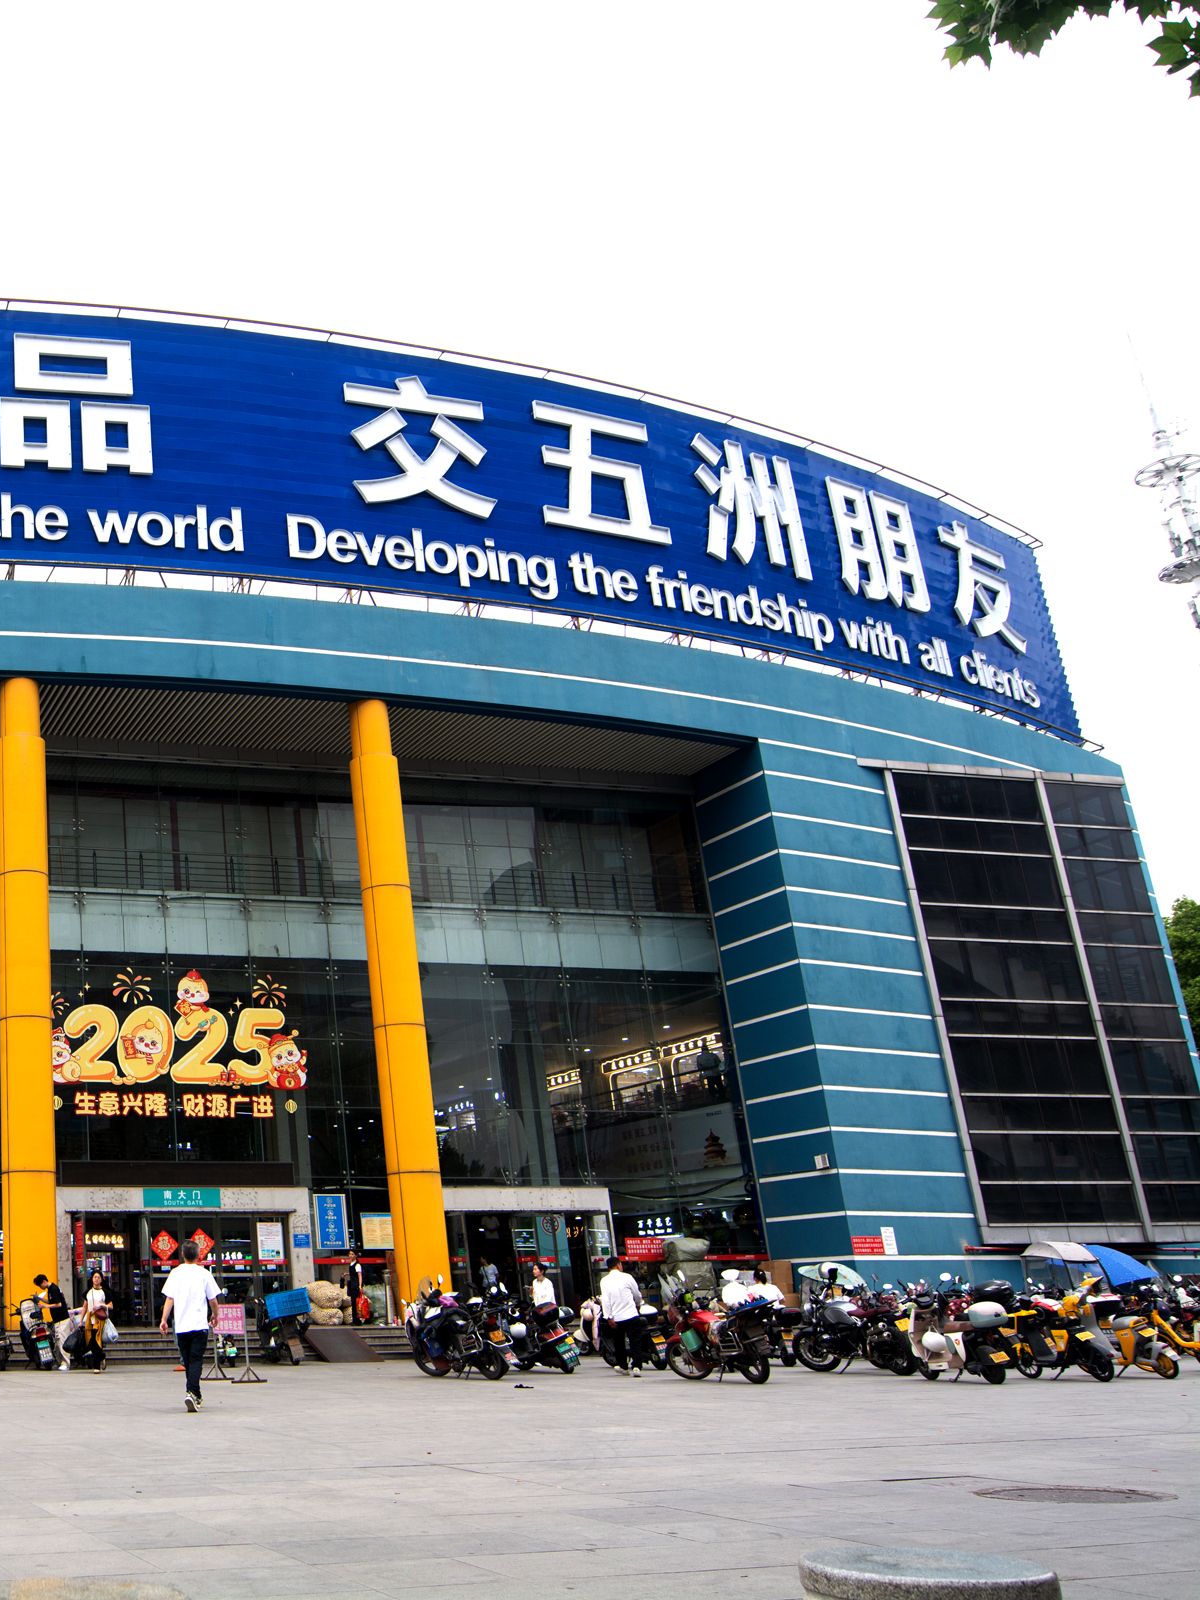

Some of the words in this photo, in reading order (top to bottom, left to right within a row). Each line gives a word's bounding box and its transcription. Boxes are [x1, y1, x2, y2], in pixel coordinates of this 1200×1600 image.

[87, 504, 246, 552] world
[342, 375, 1027, 654] 交五洲朋友
[285, 512, 558, 600] Developing
[568, 552, 640, 603] the
[646, 565, 836, 652] friendship
[837, 615, 911, 668] with
[917, 636, 954, 678] all
[959, 650, 1043, 709] clients
[63, 1003, 286, 1086] 2025
[74, 1091, 168, 1117] 生意兴隆
[182, 1093, 275, 1119] 财源广进
[163, 1189, 201, 1200] 南大门
